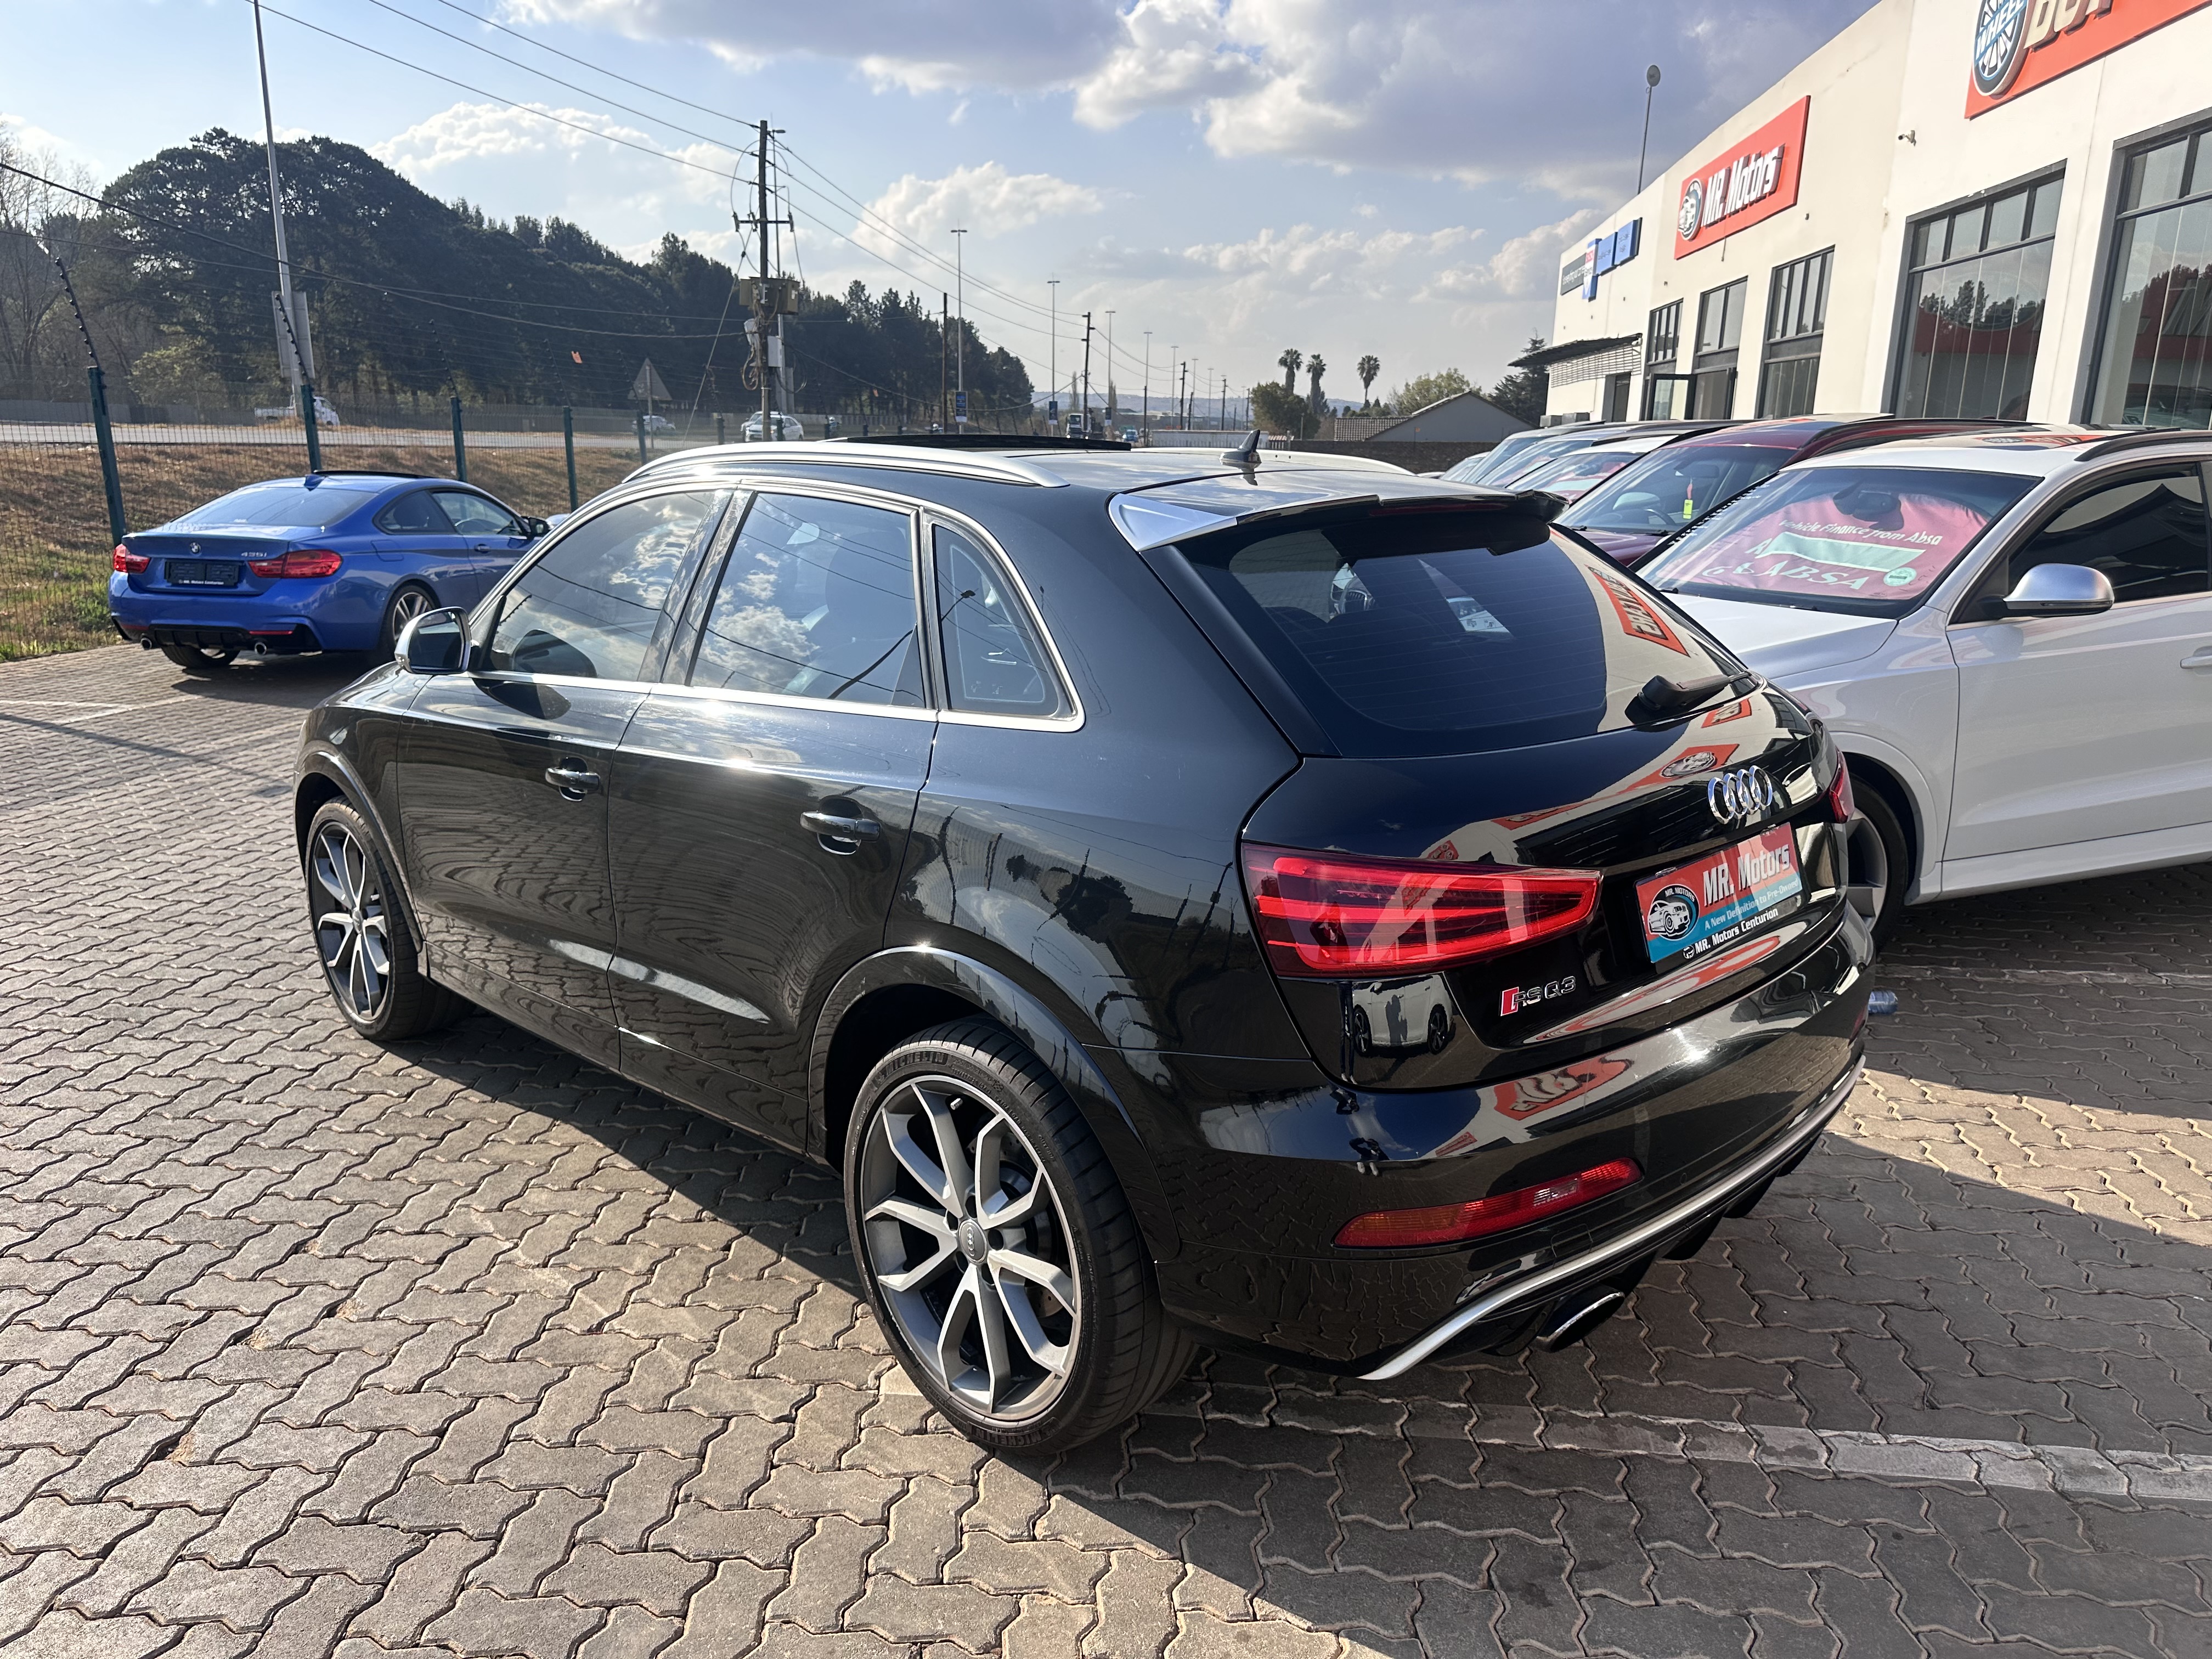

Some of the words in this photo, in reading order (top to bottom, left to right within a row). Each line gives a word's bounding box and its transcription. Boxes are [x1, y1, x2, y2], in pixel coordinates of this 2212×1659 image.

[1701, 167, 1730, 227] MR.
[1724, 144, 1783, 216] Motors
[1779, 520, 1821, 532] Vehicle
[1819, 523, 1870, 535] Finance
[1863, 528, 1905, 540] from
[1903, 531, 1943, 545] Absa
[1753, 560, 1870, 590] ABSA
[1703, 862, 1735, 907] MR.
[1737, 844, 1791, 891] Motors
[1664, 888, 1675, 898] MR.
[1674, 887, 1695, 902] MOTORS
[1705, 920, 1711, 931] A
[1711, 913, 1726, 928] New
[1726, 899, 1759, 919] Definition
[1758, 894, 1767, 905] to
[1767, 878, 1799, 900] Pre-Owned
[1695, 938, 1711, 954] MR.
[1712, 926, 1740, 946] Motors
[1741, 907, 1779, 932] Centurion
[885, 1052, 945, 1076] MICHELIN
[975, 1429, 1041, 1446] MICHELIN
